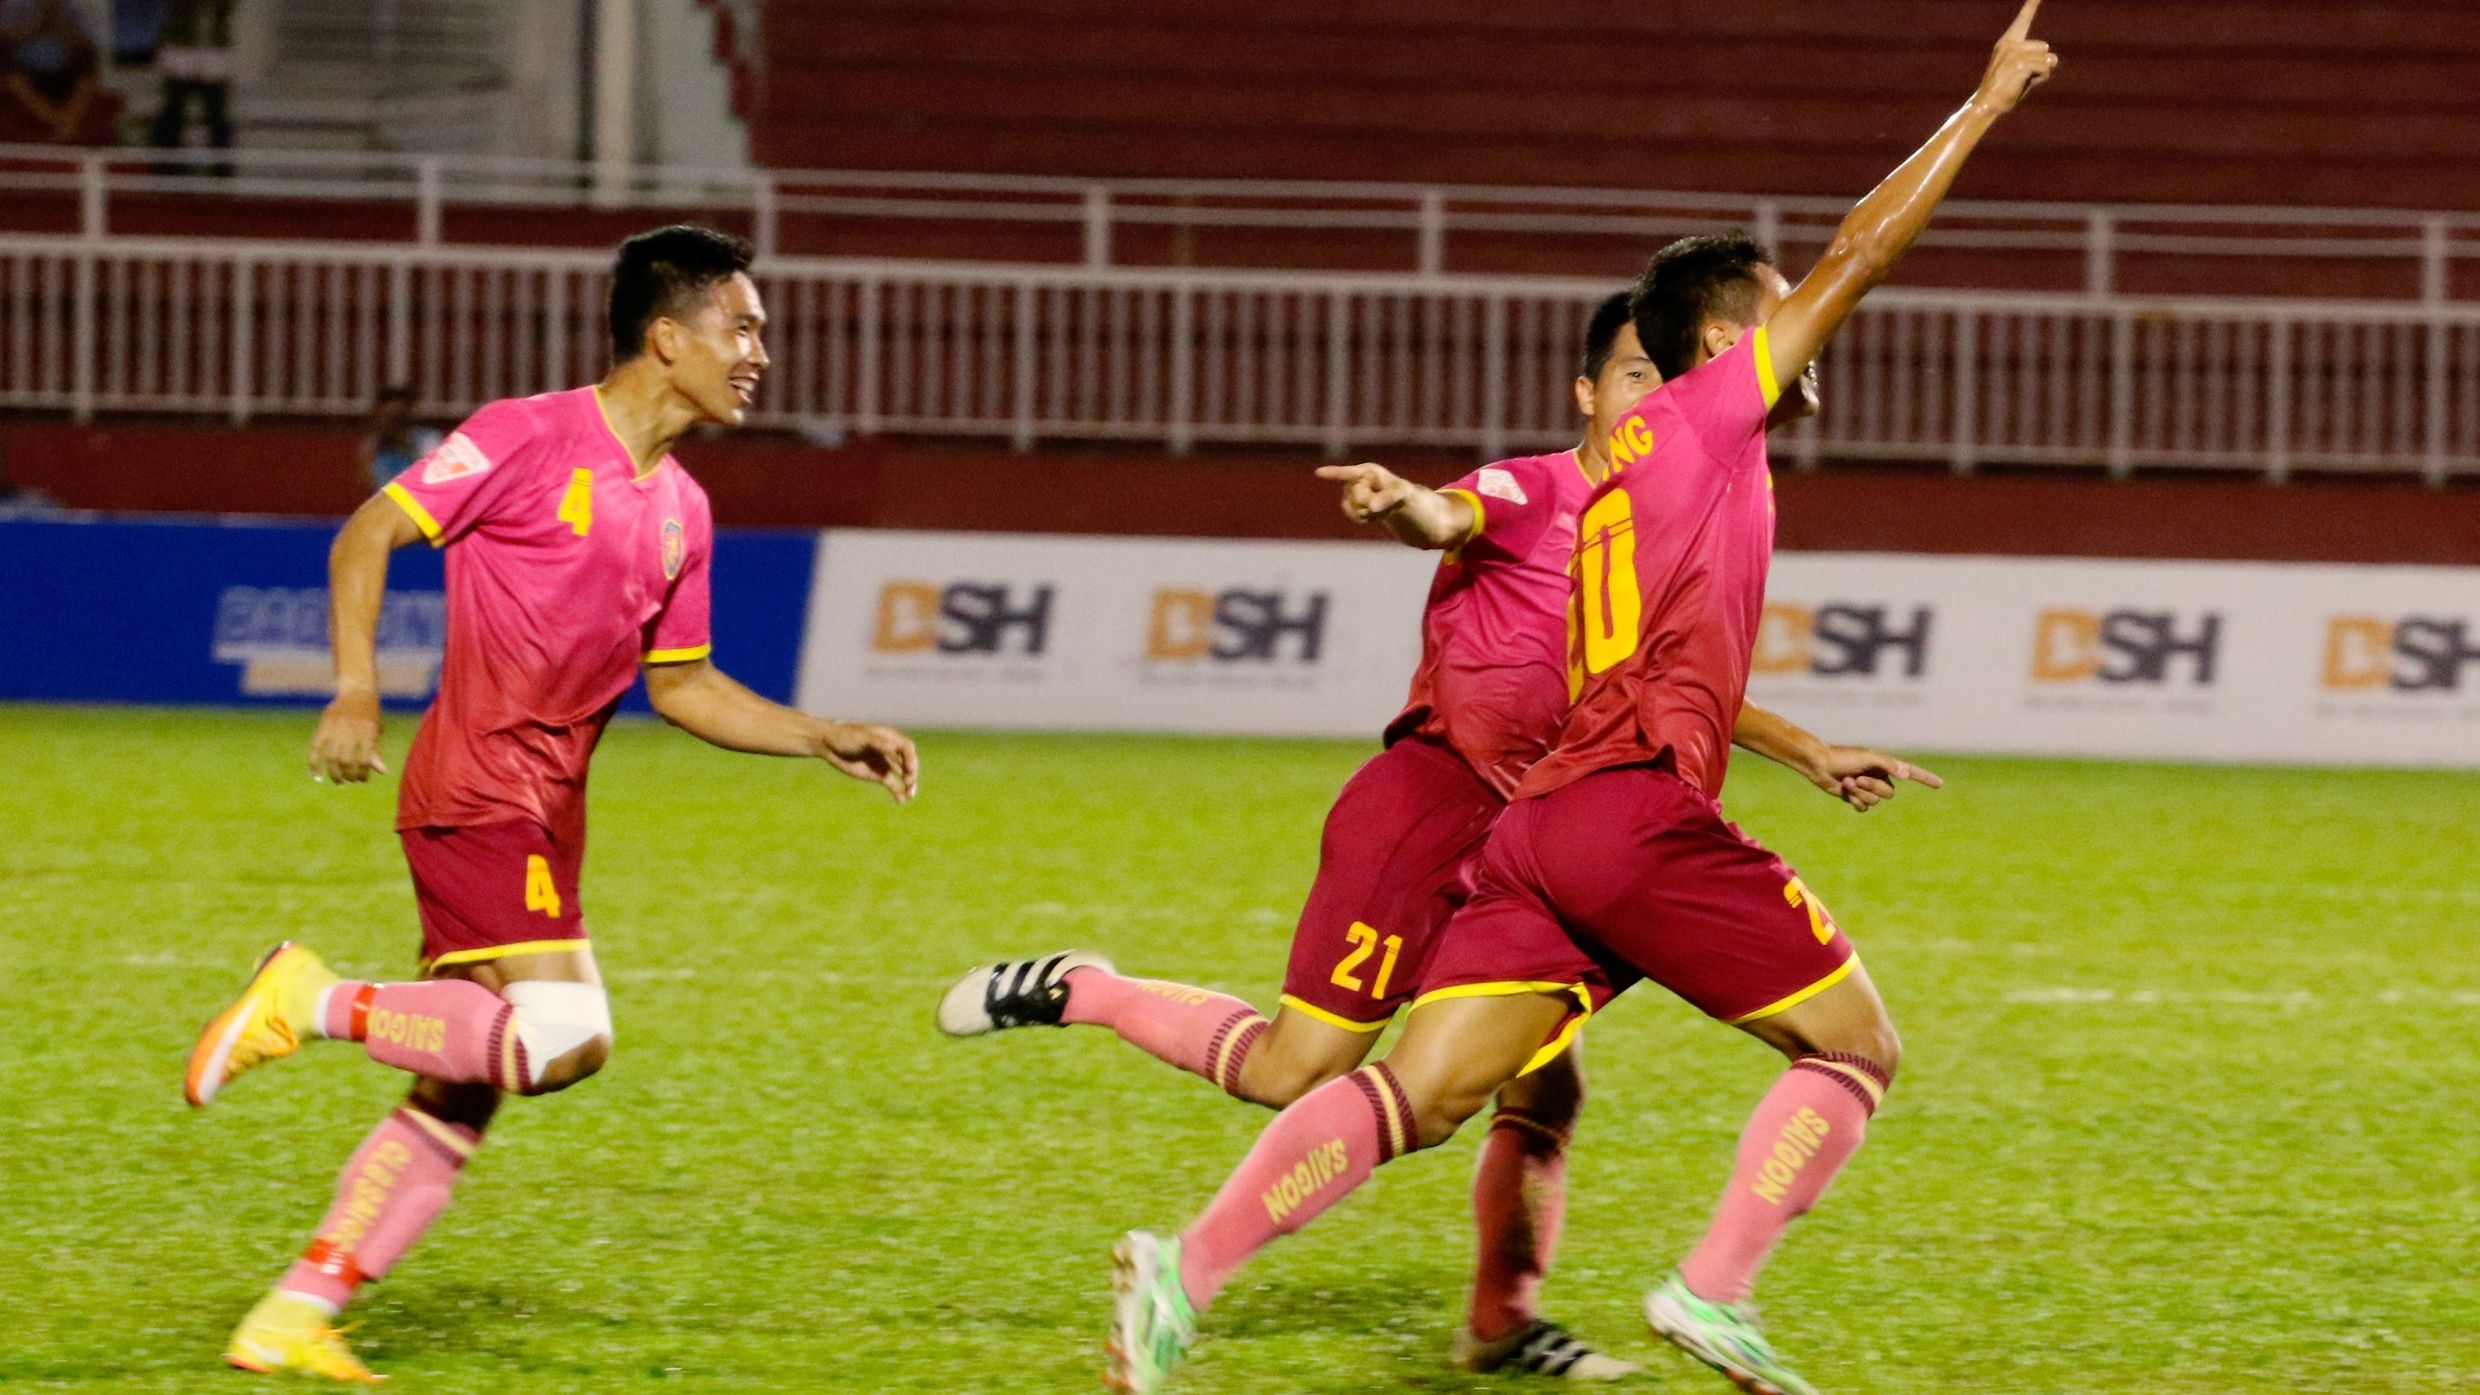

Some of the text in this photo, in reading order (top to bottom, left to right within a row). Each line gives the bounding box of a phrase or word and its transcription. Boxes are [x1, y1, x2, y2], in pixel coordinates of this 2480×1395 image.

[1602, 415, 1654, 482] NG
[557, 467, 593, 537] 4
[873, 580, 1056, 656] DSH
[1144, 586, 1331, 663] DSH
[1751, 601, 1934, 678] DSH
[2031, 608, 2221, 685] DSH
[526, 854, 561, 918] 4
[1784, 876, 1837, 945] 2
[1330, 921, 1403, 1000] 21
[1262, 1138, 1348, 1224] SAIGON
[1751, 1107, 1831, 1206] SAIGON
